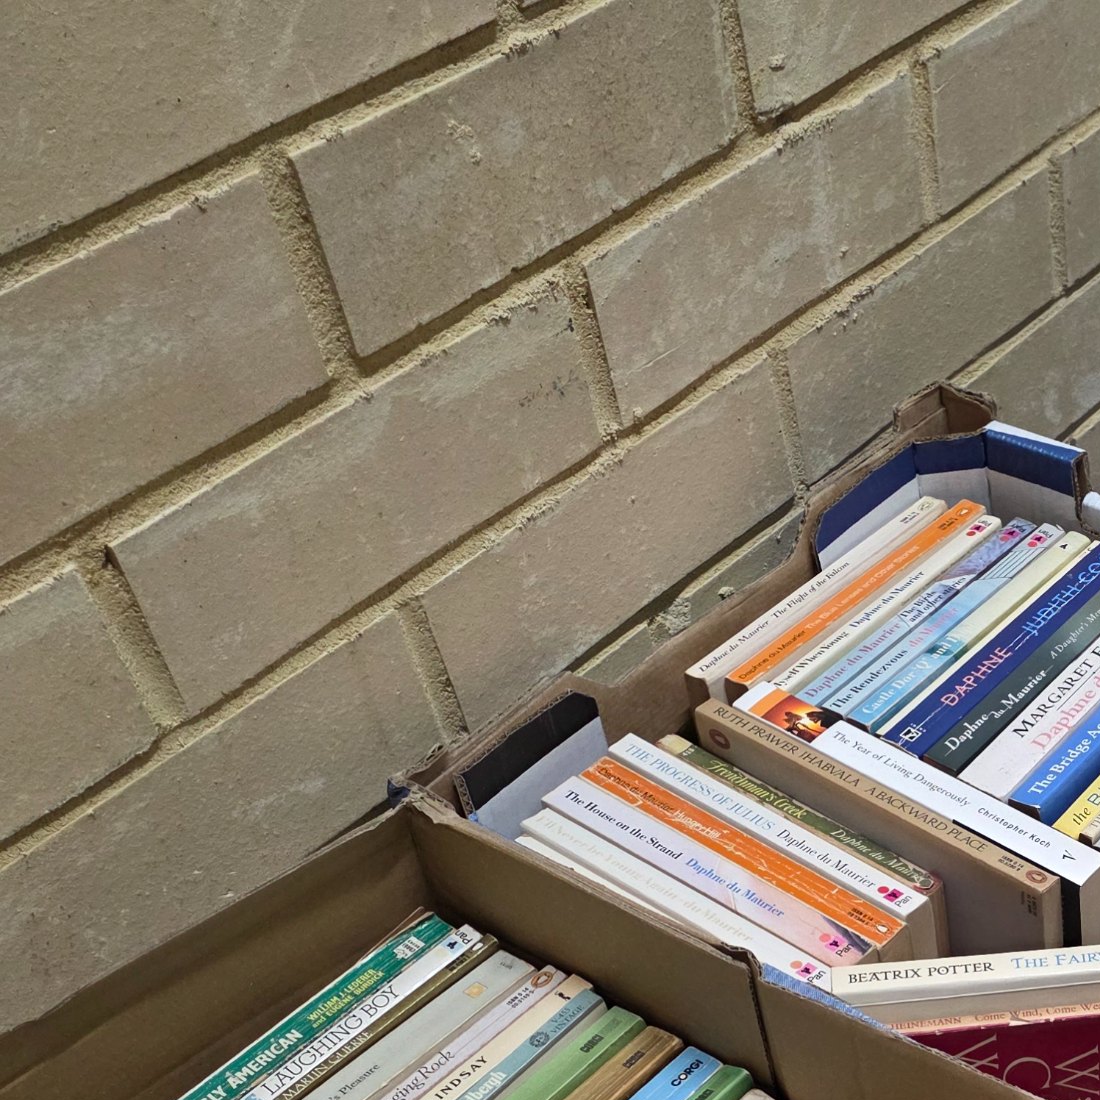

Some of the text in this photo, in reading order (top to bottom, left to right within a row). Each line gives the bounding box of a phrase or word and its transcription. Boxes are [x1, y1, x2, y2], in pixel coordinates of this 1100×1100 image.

[1013, 661, 1092, 737] MARGARET
[713, 706, 749, 728] RUTH
[748, 725, 799, 753] PRAWER
[865, 785, 877, 796] A
[875, 791, 948, 831] BACKWARD
[947, 827, 987, 852] PLACE
[1027, 772, 1057, 795] The
[1050, 739, 1092, 773] Bridge
[849, 968, 920, 984] BEATRIX
[928, 962, 993, 977] POTTER
[1011, 955, 1048, 969] THE
[223, 1029, 306, 1089] AMERICAN
[416, 1049, 454, 1079] Rock
